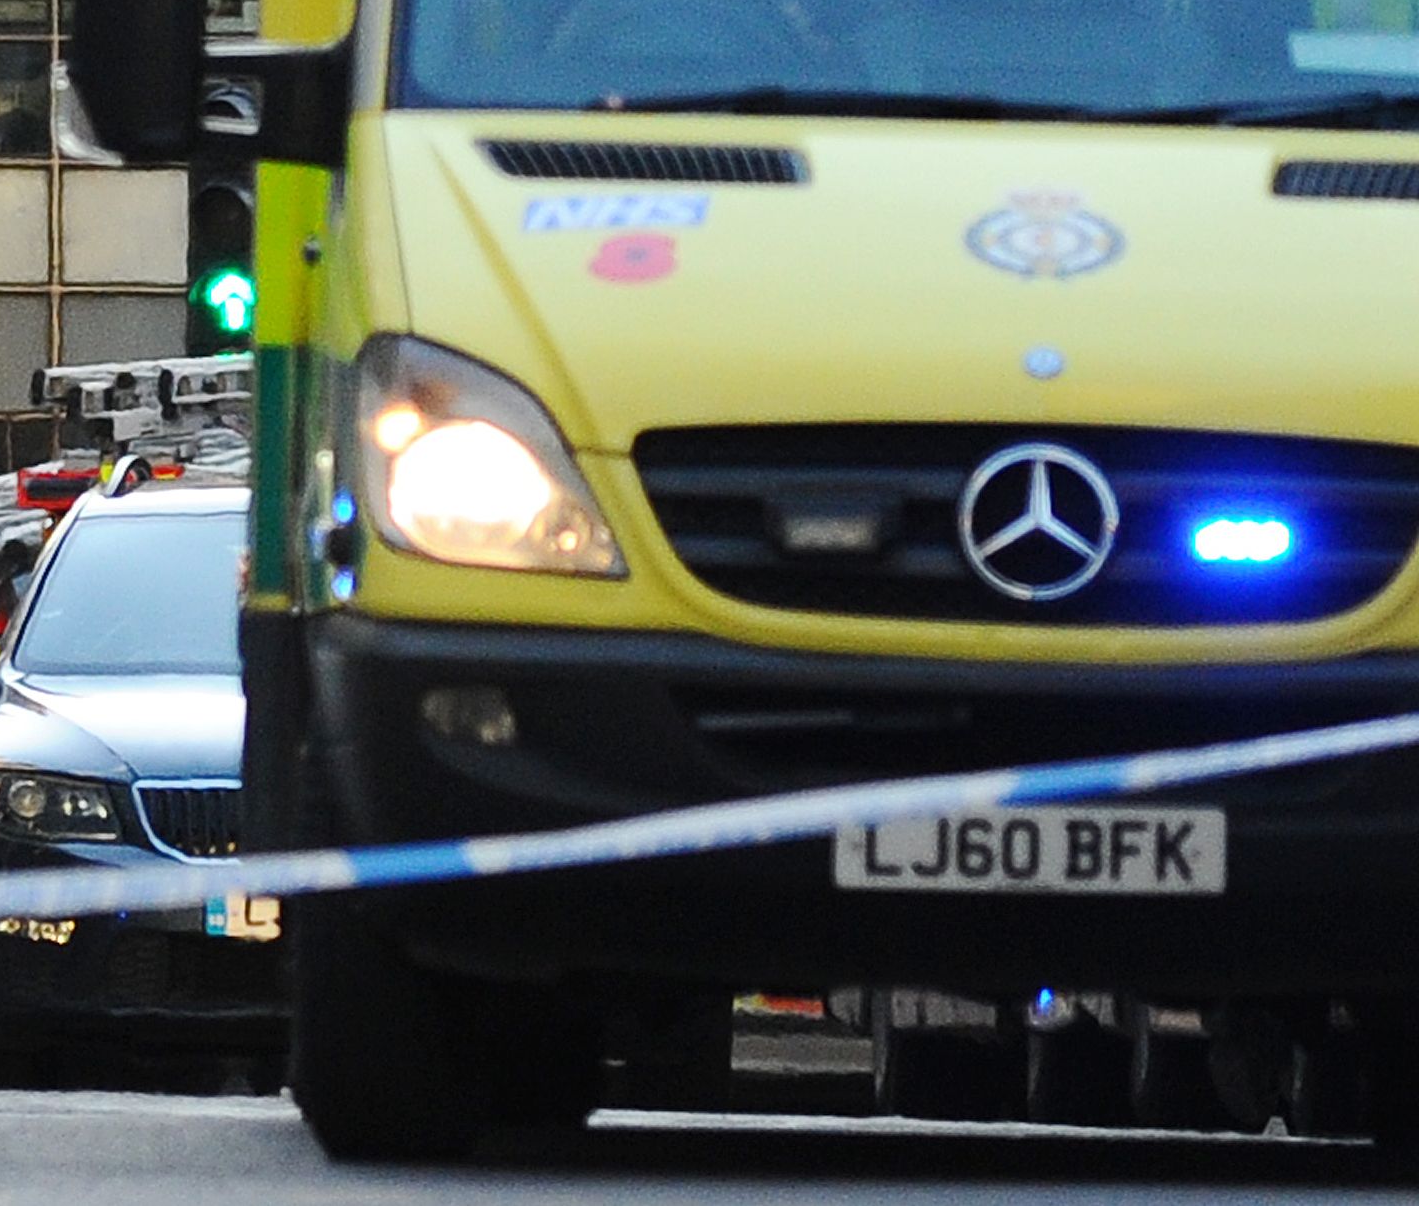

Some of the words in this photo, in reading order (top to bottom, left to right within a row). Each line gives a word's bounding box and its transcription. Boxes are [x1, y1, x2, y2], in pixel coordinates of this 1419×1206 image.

[525, 195, 703, 230] NHS
[864, 817, 1041, 880] LJ60
[1065, 819, 1195, 882] BFK
